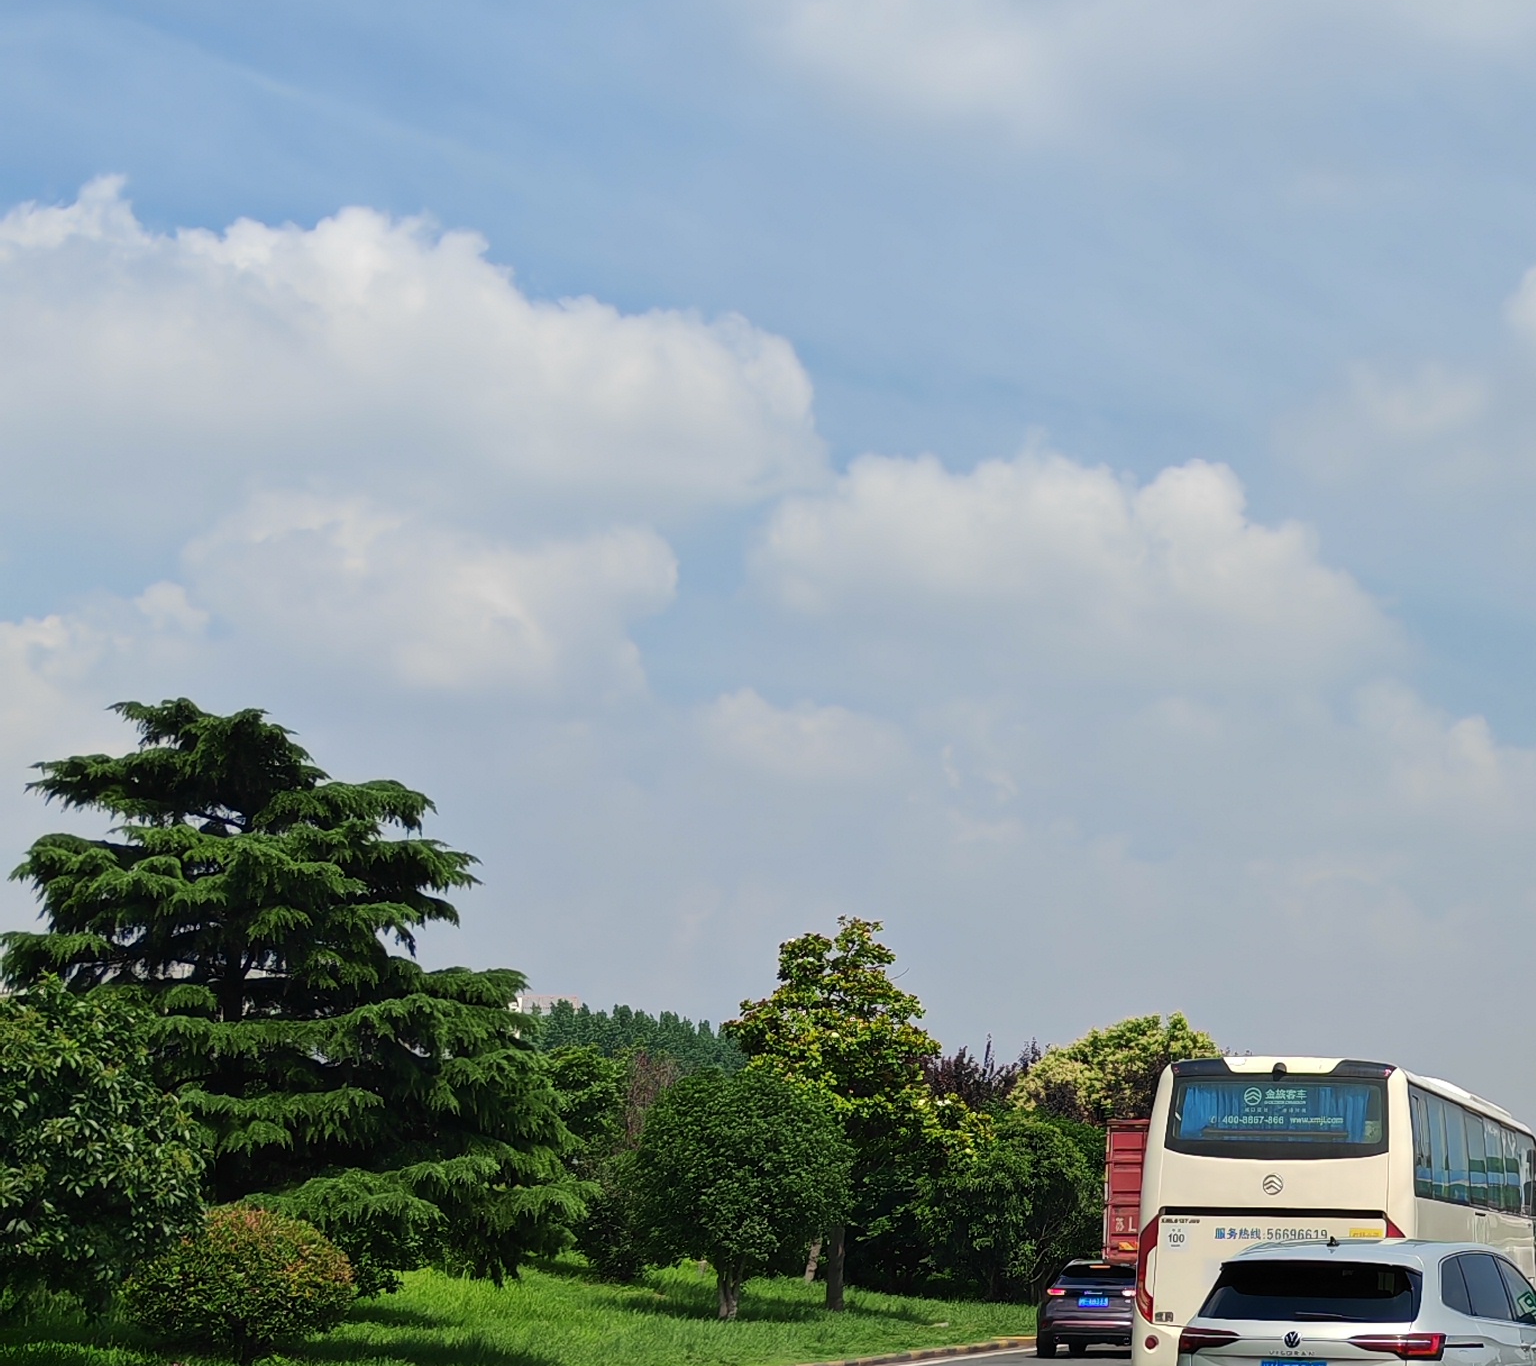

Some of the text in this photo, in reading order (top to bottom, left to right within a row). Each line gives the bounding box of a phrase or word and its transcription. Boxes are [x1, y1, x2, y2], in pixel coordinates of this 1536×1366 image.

[1265, 1088, 1307, 1100] 金旅客车
[1168, 1233, 1185, 1243] 100
